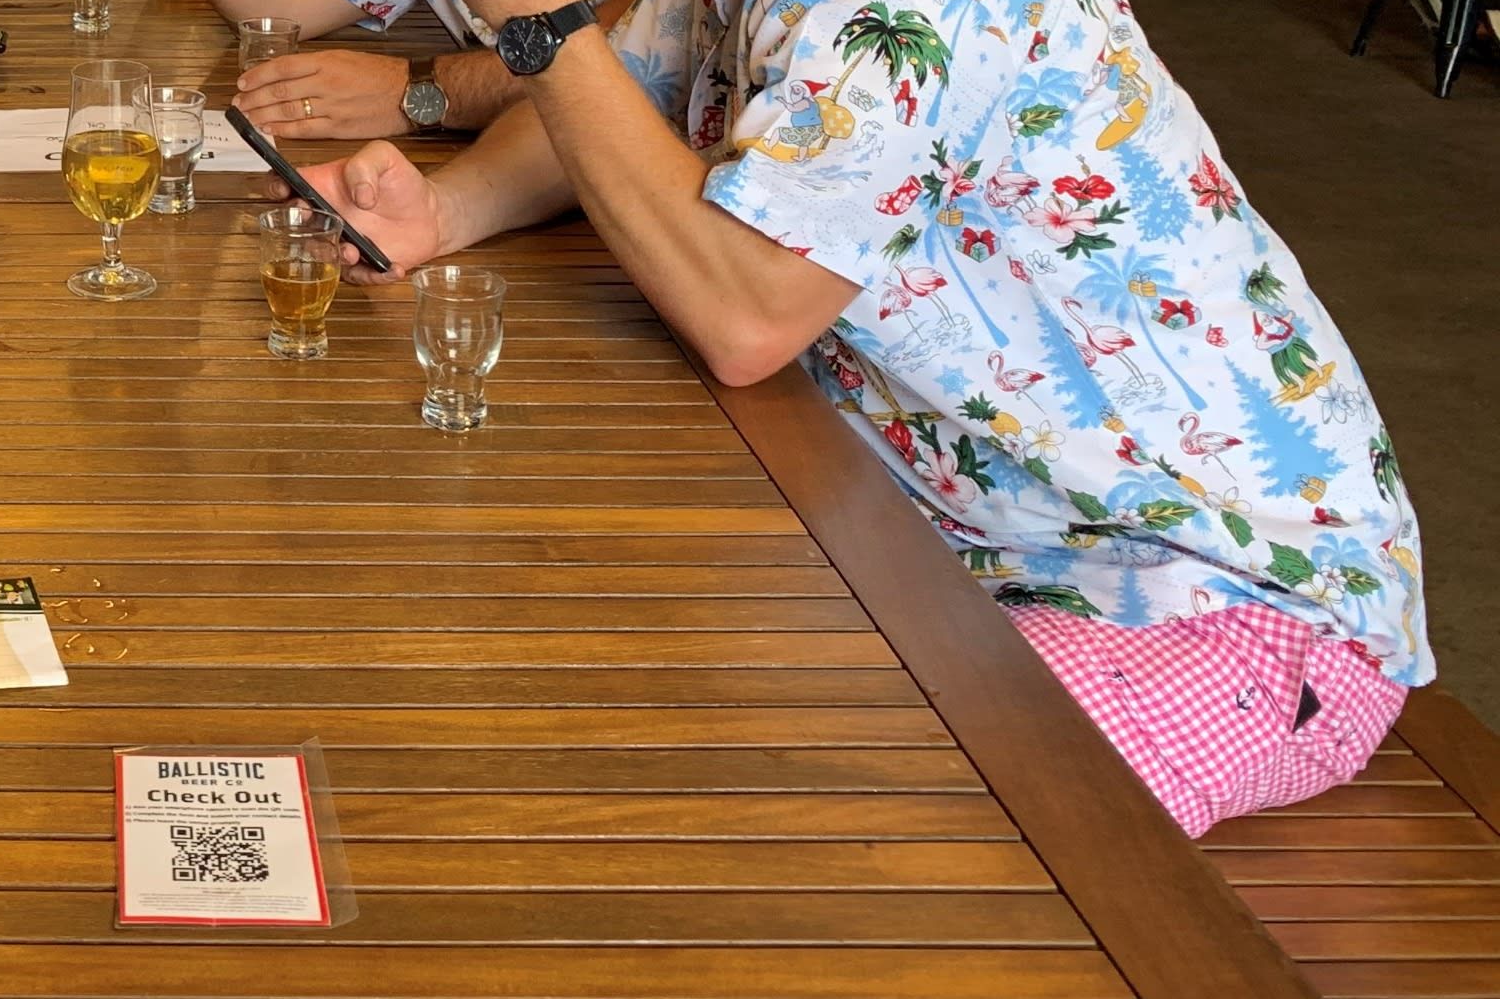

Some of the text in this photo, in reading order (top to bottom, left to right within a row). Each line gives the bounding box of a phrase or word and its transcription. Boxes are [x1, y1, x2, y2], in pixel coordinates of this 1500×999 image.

[158, 761, 265, 780] BALLISTIC
[147, 789, 282, 804] Check Out
